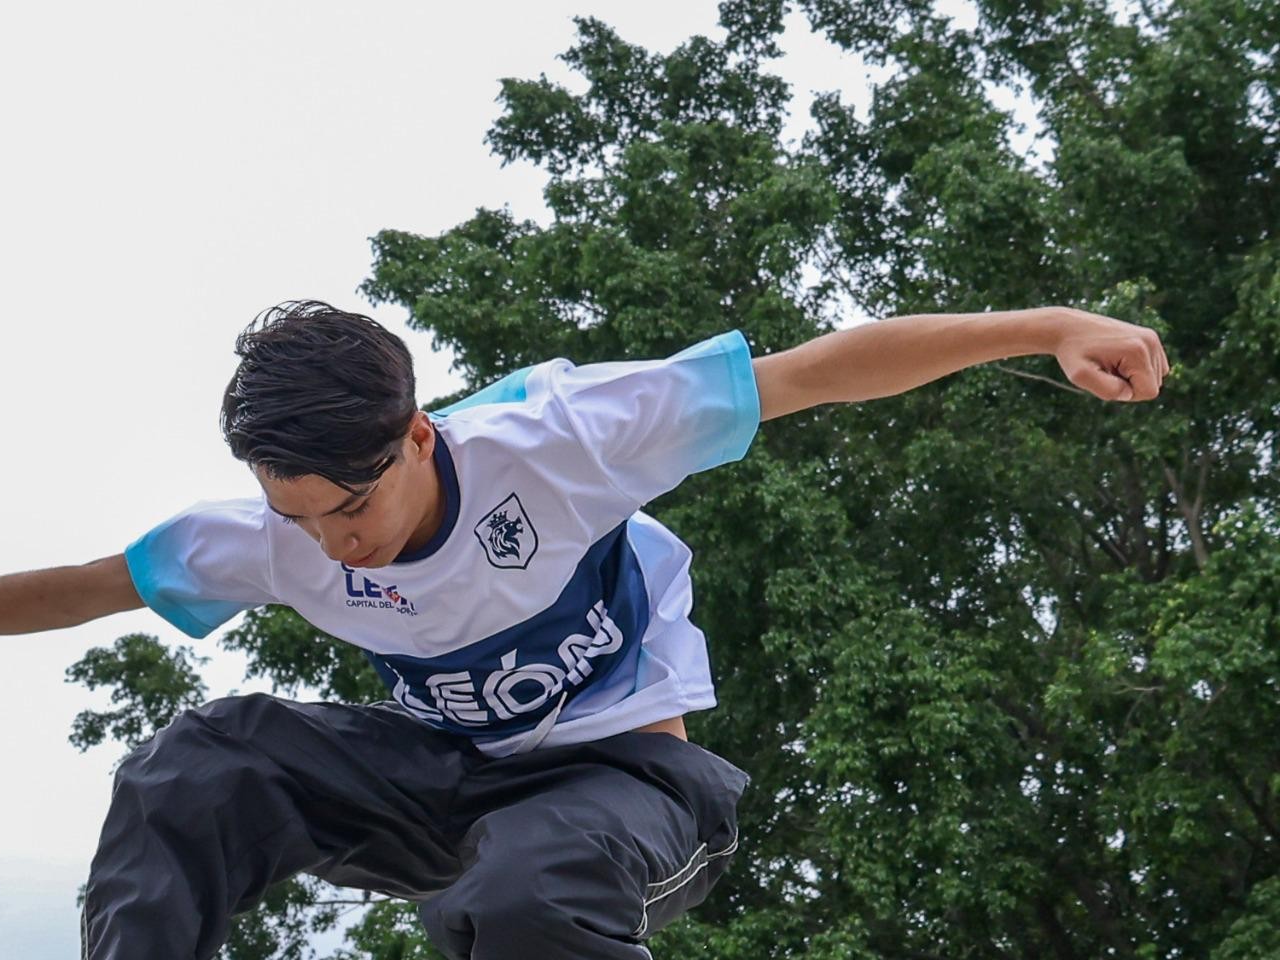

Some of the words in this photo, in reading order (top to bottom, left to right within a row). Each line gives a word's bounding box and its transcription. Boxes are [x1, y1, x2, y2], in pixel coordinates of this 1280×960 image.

[346, 600, 378, 608] CAPITAL
[380, 601, 394, 609] DEL
[387, 600, 623, 726] LEÓN
